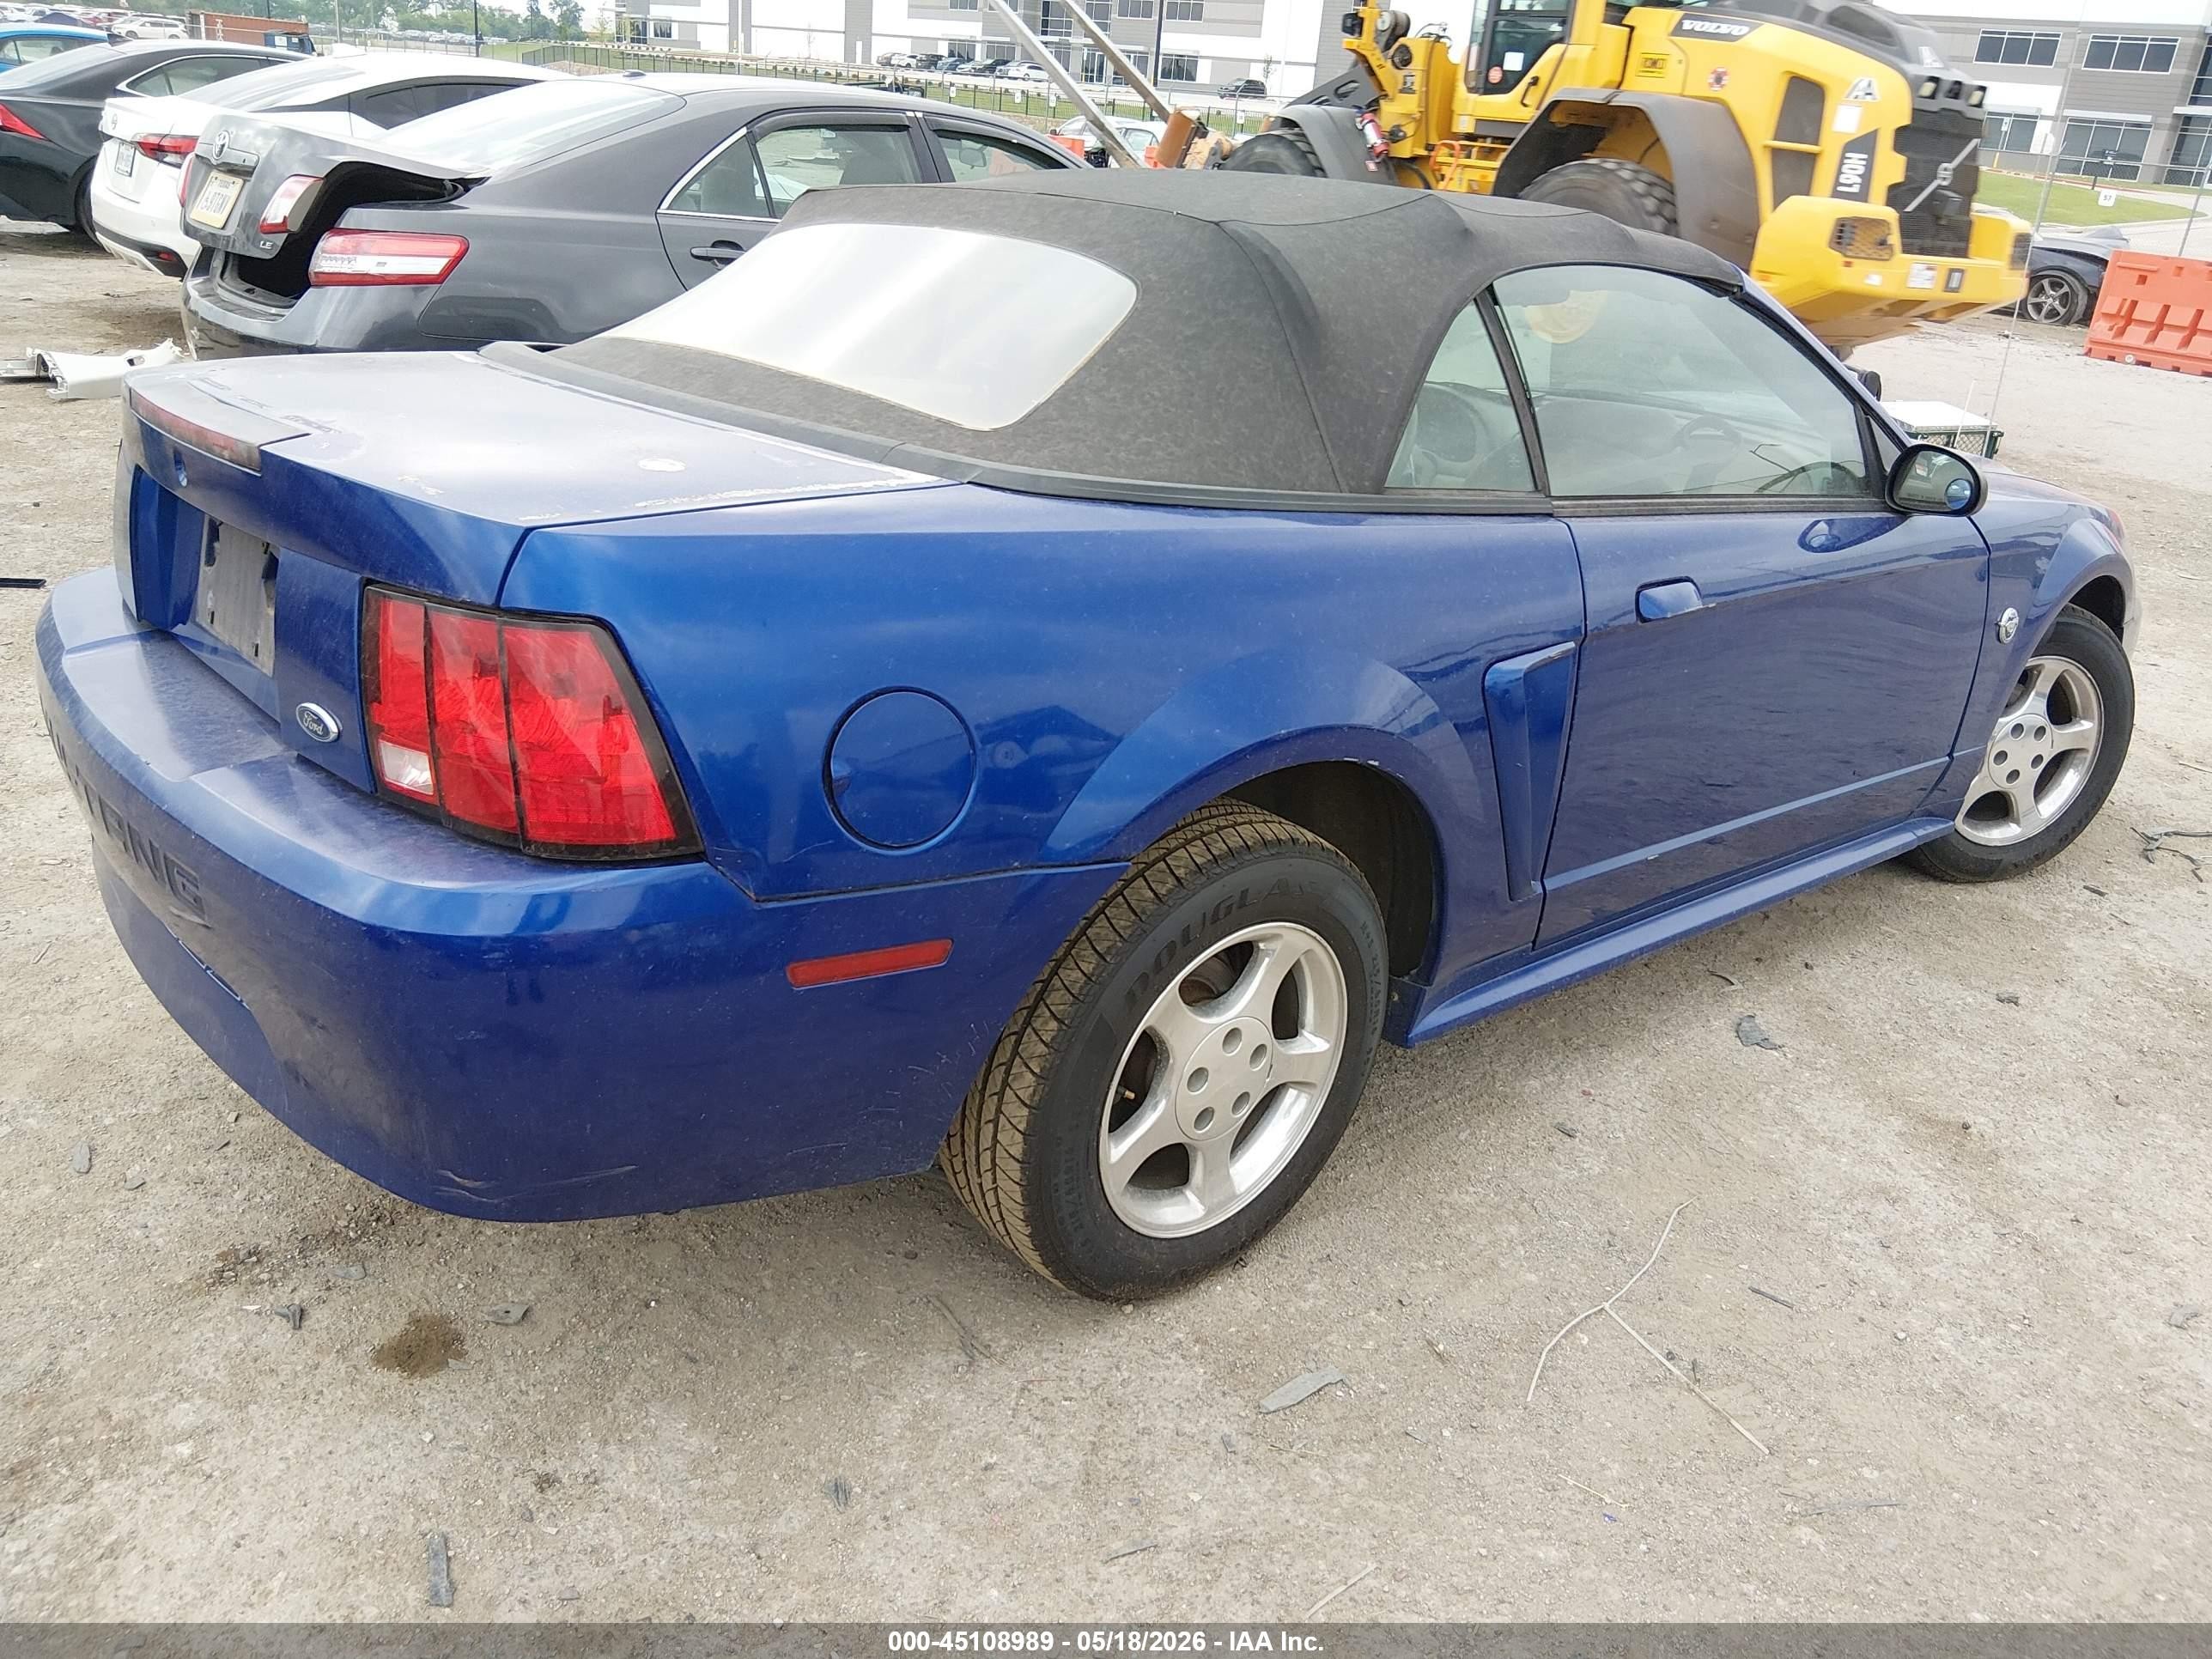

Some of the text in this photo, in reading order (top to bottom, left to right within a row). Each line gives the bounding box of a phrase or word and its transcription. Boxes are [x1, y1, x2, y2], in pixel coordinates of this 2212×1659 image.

[1681, 19, 1750, 36] VOLVO
[1837, 152, 1869, 193] L90H
[260, 240, 273, 249] LE
[303, 711, 324, 735] Ford
